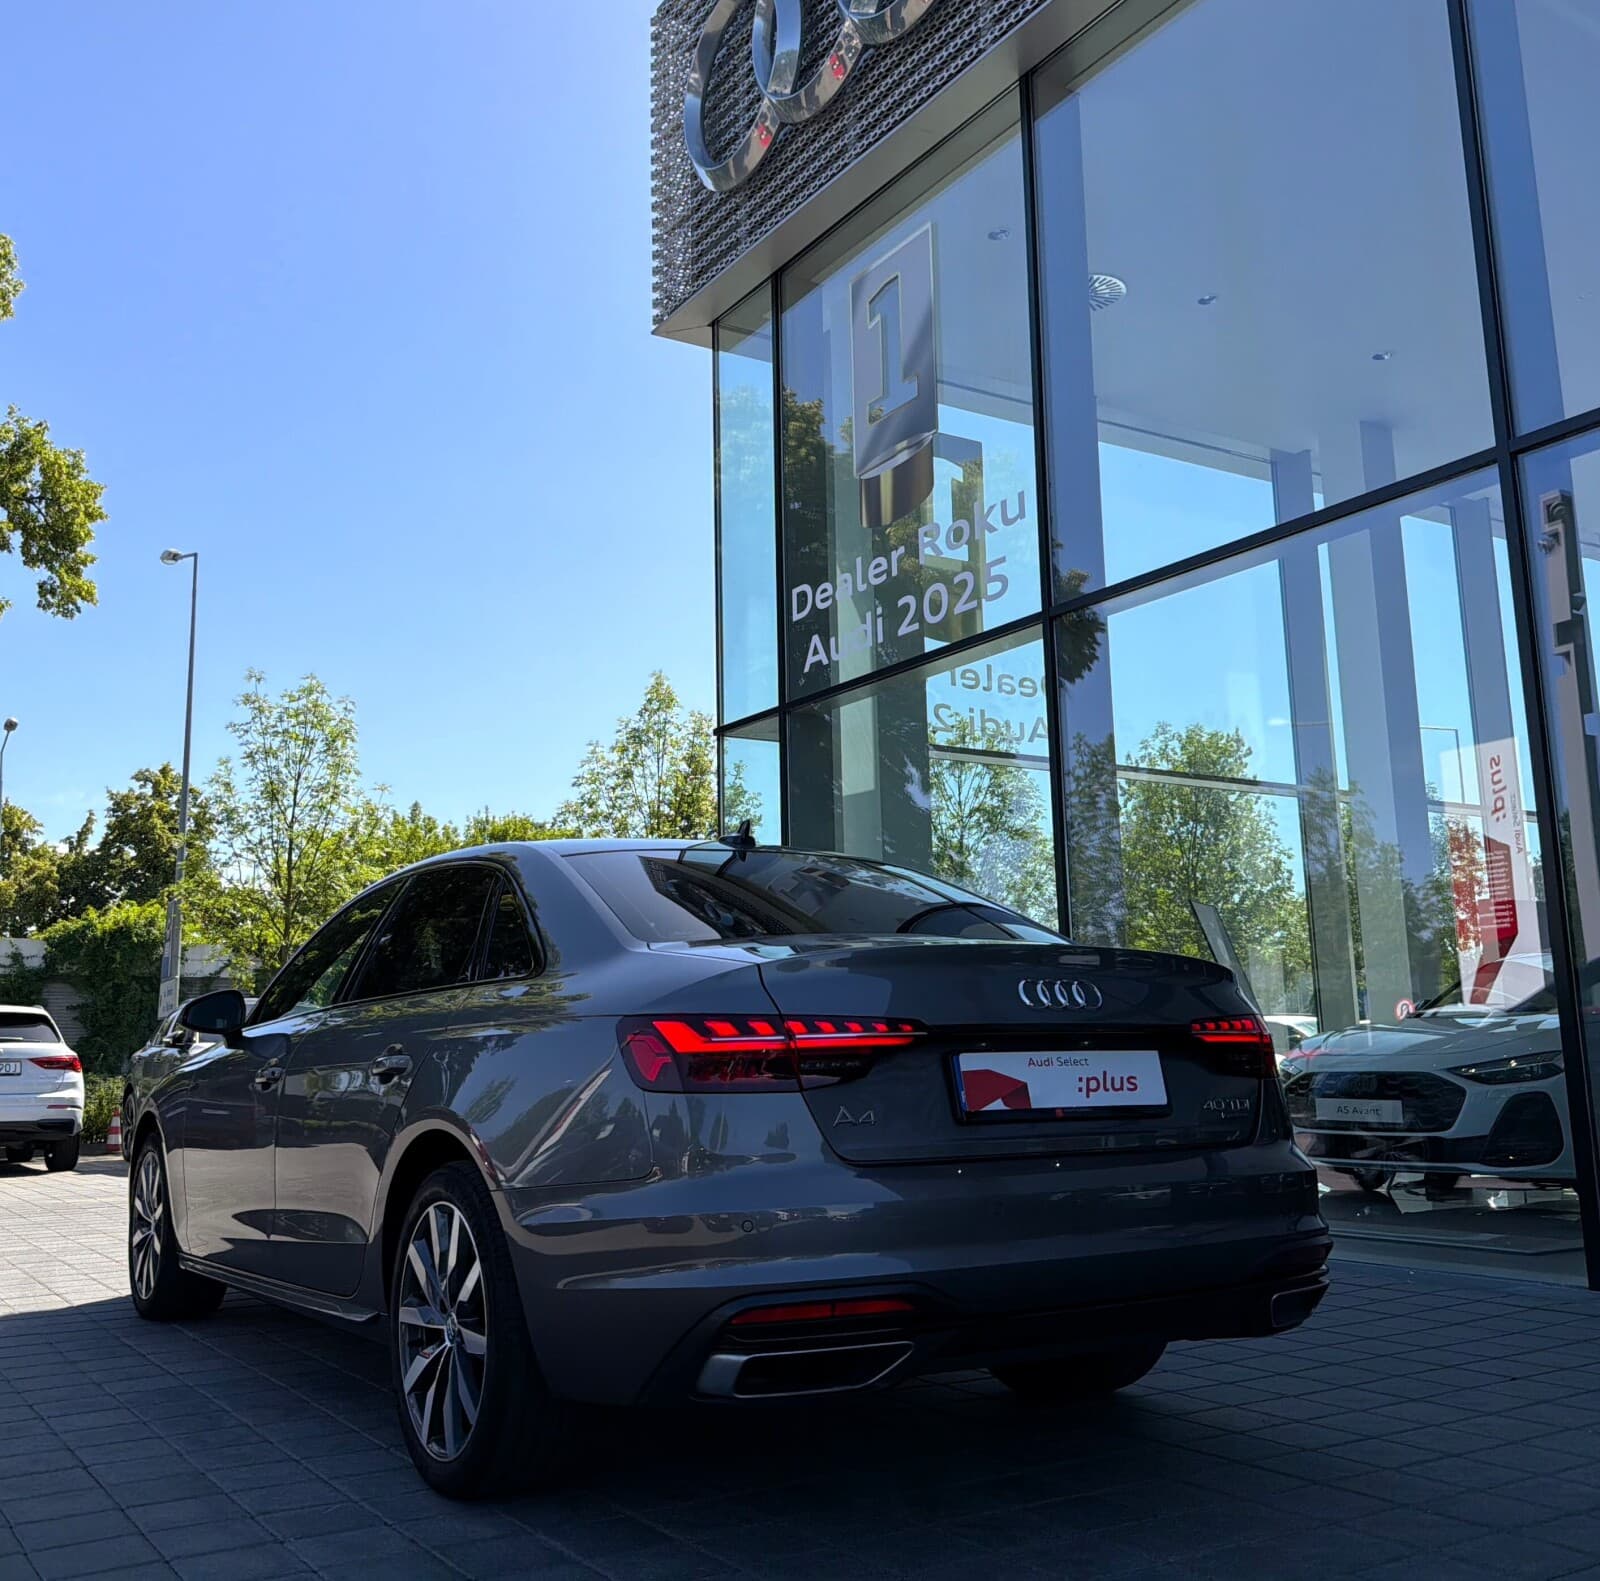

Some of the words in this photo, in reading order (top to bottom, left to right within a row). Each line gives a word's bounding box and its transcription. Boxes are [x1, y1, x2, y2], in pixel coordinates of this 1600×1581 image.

[791, 545, 905, 623] Dealer
[918, 490, 1026, 566] Roku
[803, 607, 884, 674] Audi
[897, 556, 1009, 637] 2025
[1027, 1057, 1054, 1067] Audi
[1056, 1057, 1089, 1067] Select
[1078, 1070, 1138, 1098] :plus
[832, 1105, 875, 1127] A4
[1336, 1105, 1350, 1114] A5
